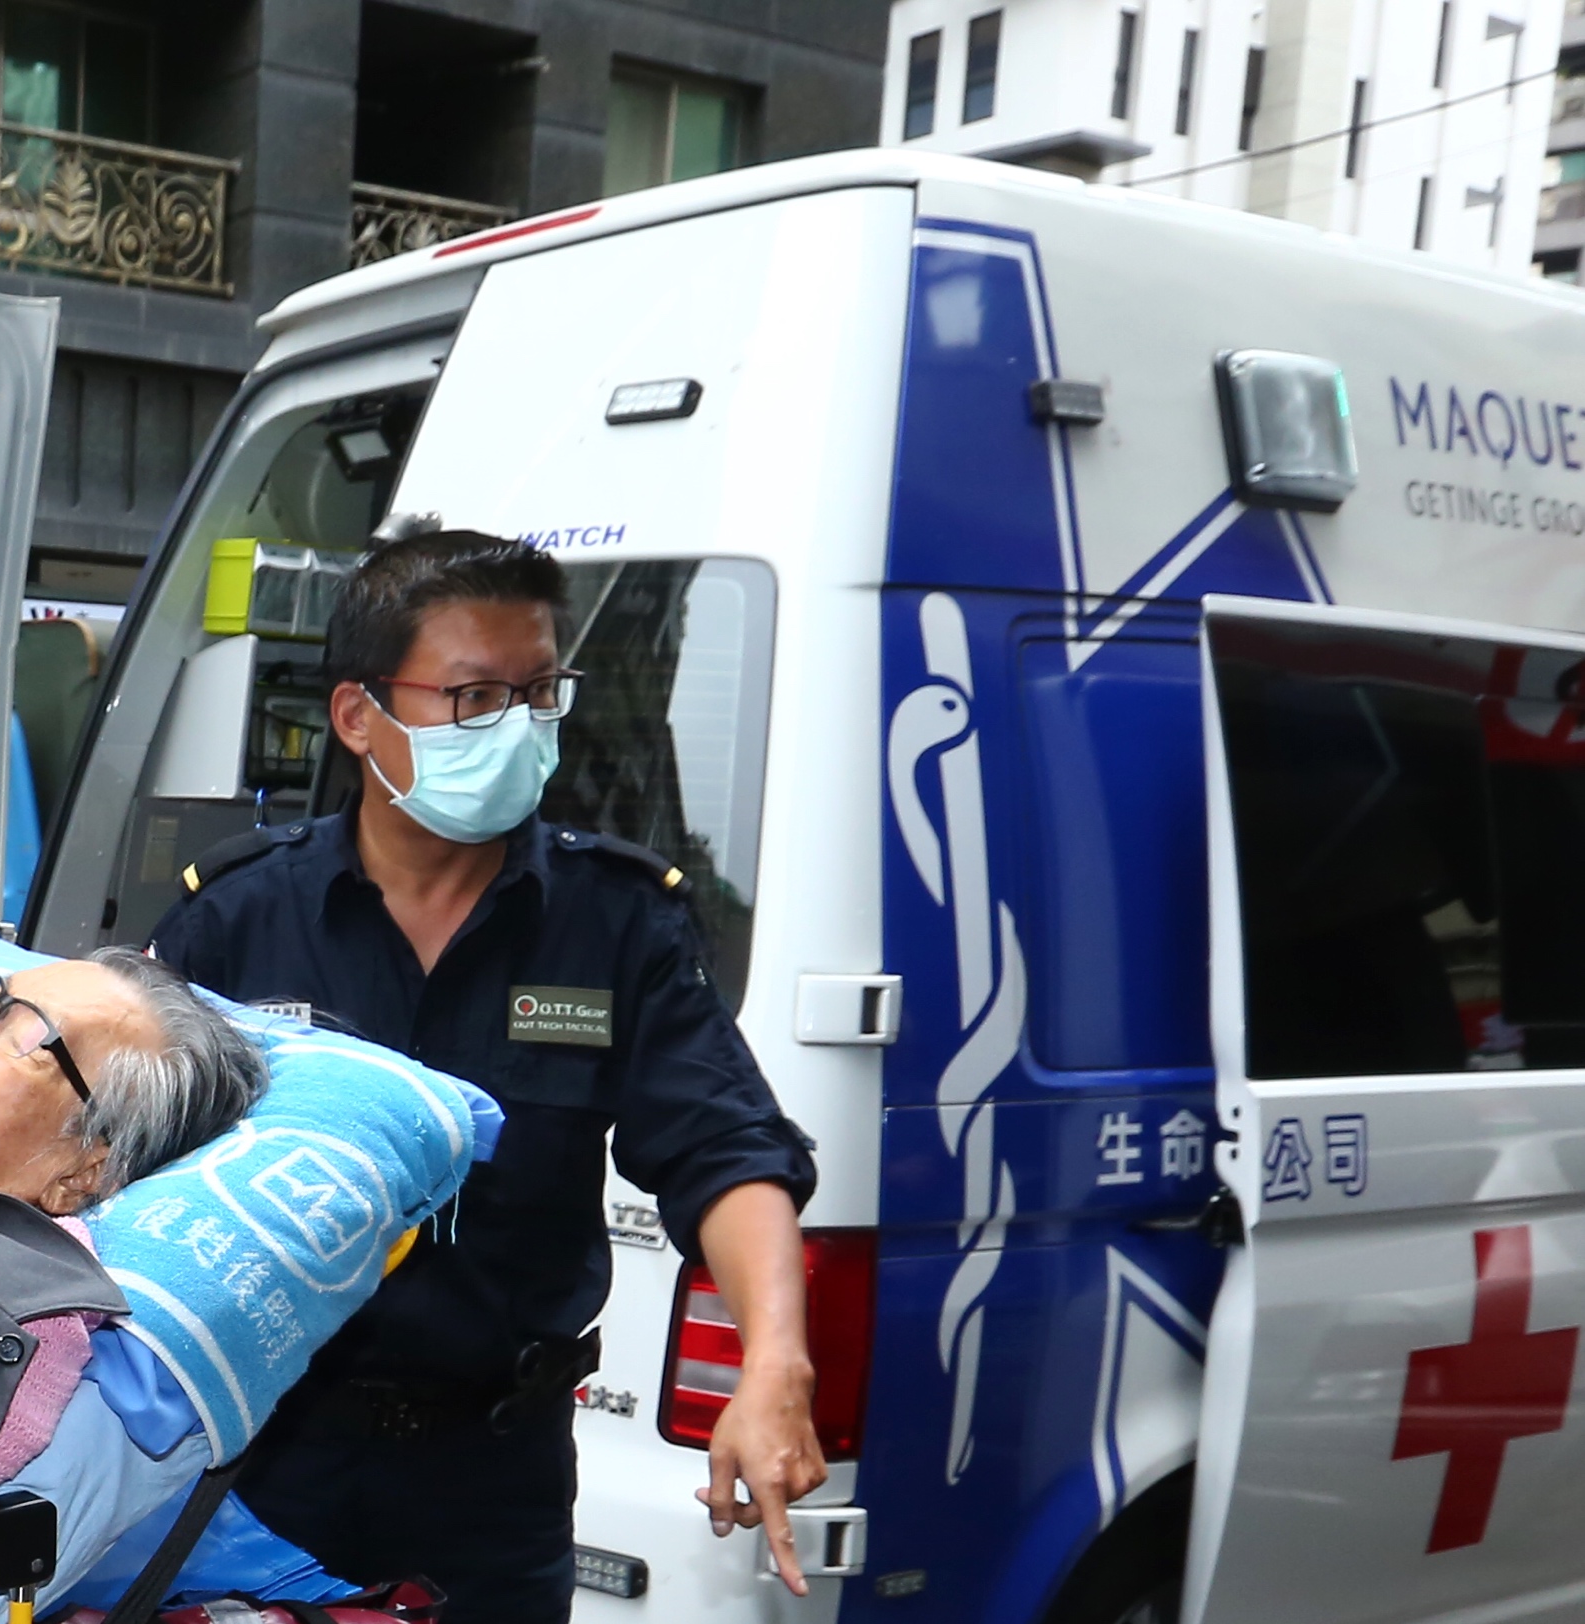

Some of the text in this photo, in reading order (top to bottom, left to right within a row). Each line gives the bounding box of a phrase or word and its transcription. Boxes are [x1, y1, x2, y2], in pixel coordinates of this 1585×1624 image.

[1387, 375, 1585, 472] MAQUE
[1403, 479, 1524, 530] GETINGE
[516, 523, 627, 550] WATCH
[513, 1020, 535, 1030] OUT
[1095, 1108, 1369, 1202] 生命 公司
